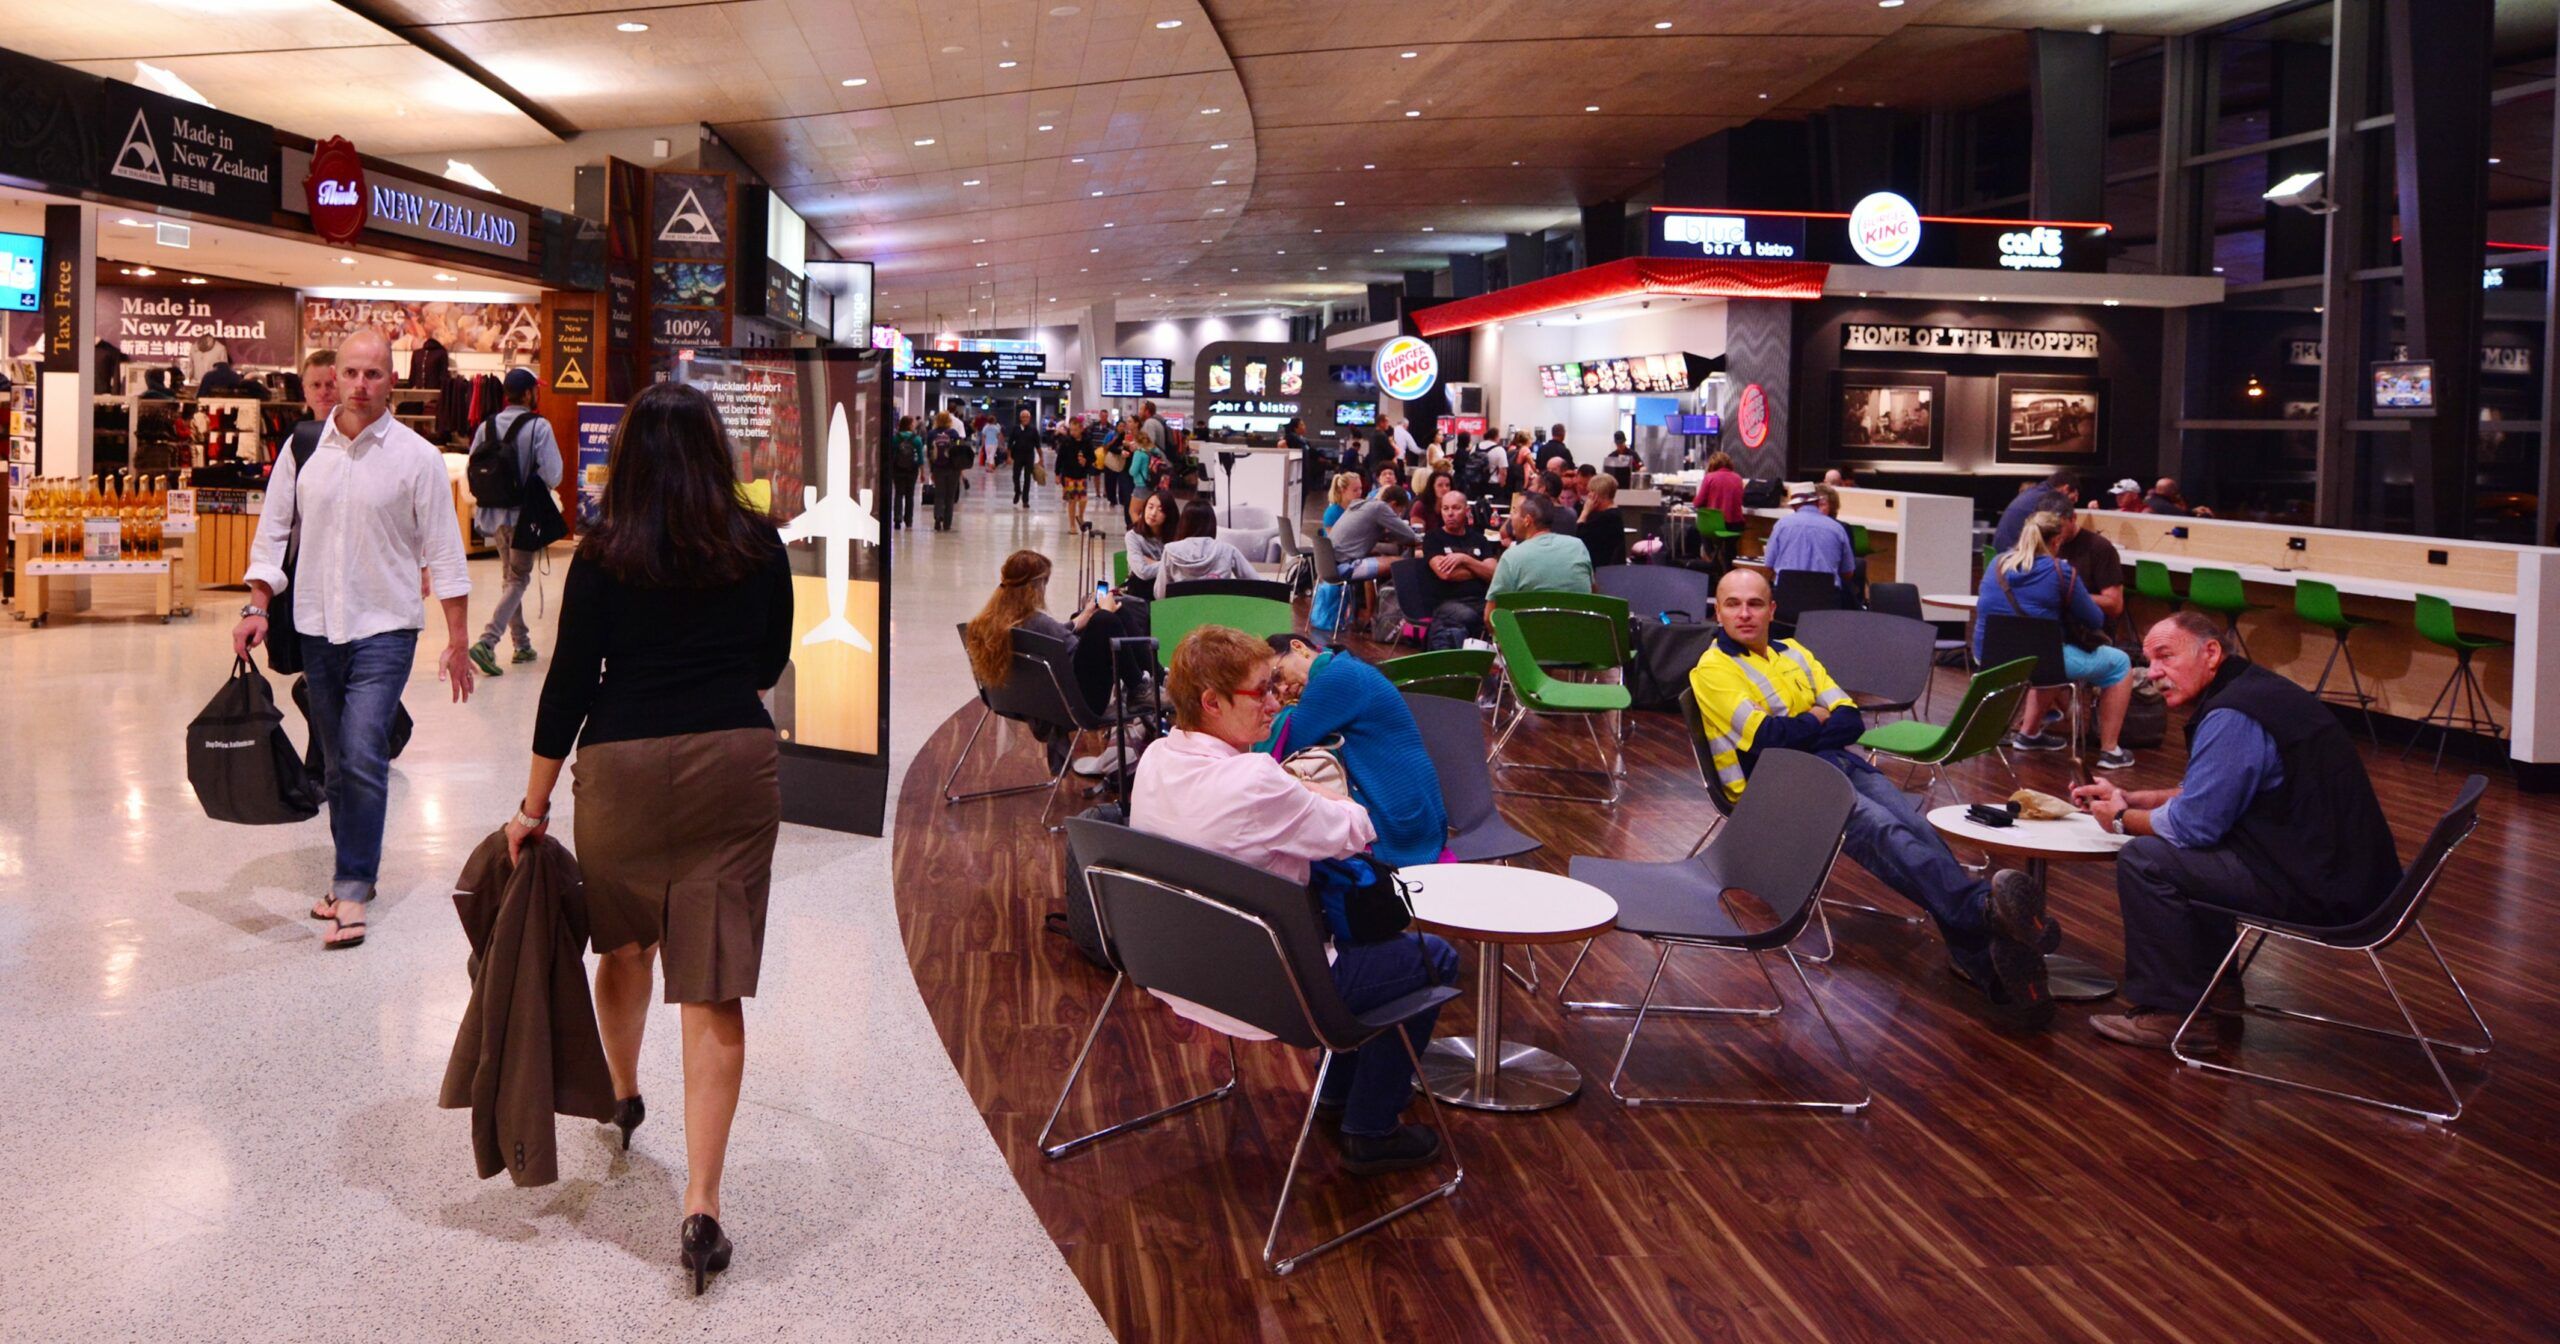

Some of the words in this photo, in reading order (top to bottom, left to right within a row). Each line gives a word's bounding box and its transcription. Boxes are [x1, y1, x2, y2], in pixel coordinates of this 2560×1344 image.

[173, 116, 215, 147] Made
[219, 130, 233, 151] in
[172, 142, 208, 169] New
[212, 152, 269, 184] Zealand
[317, 180, 360, 206] Think
[373, 185, 423, 226] NEW
[428, 200, 517, 248] ZEALAND
[1685, 218, 1745, 245] blue
[1865, 220, 1909, 245] KING
[1702, 241, 1735, 256] bar
[1739, 240, 1752, 256] &
[1755, 241, 1794, 257] bistro
[54, 261, 72, 308] Free
[120, 297, 184, 317] Made
[189, 299, 212, 317] in
[308, 302, 350, 321] Tax
[356, 303, 406, 324] Free
[54, 315, 72, 355] Tax
[120, 317, 171, 336] New
[175, 319, 267, 340] Zealand
[564, 324, 582, 332] New
[664, 319, 712, 337] 100%
[119, 339, 193, 357] 新西兰制造
[558, 334, 588, 343] Zealand
[671, 338, 700, 346] Zealand
[700, 339, 721, 347] Made
[1847, 325, 1910, 347] HOME
[1915, 327, 1944, 348] OF
[1948, 328, 1992, 350] THE
[1996, 330, 2099, 353] WHOPPER
[562, 345, 583, 353] Made
[1382, 346, 1427, 373] BURGER
[1387, 356, 1431, 387] KING
[711, 381, 751, 392] Auckland
[752, 382, 783, 394] Airport
[711, 392, 735, 403] We're
[735, 393, 766, 406] working
[1215, 400, 1241, 413] bar
[1259, 401, 1299, 414] bistro
[716, 404, 730, 414] ard
[730, 404, 758, 415] behind
[758, 405, 772, 415] the
[740, 416, 749, 426] to
[749, 417, 772, 427] make
[744, 427, 770, 438] better.
